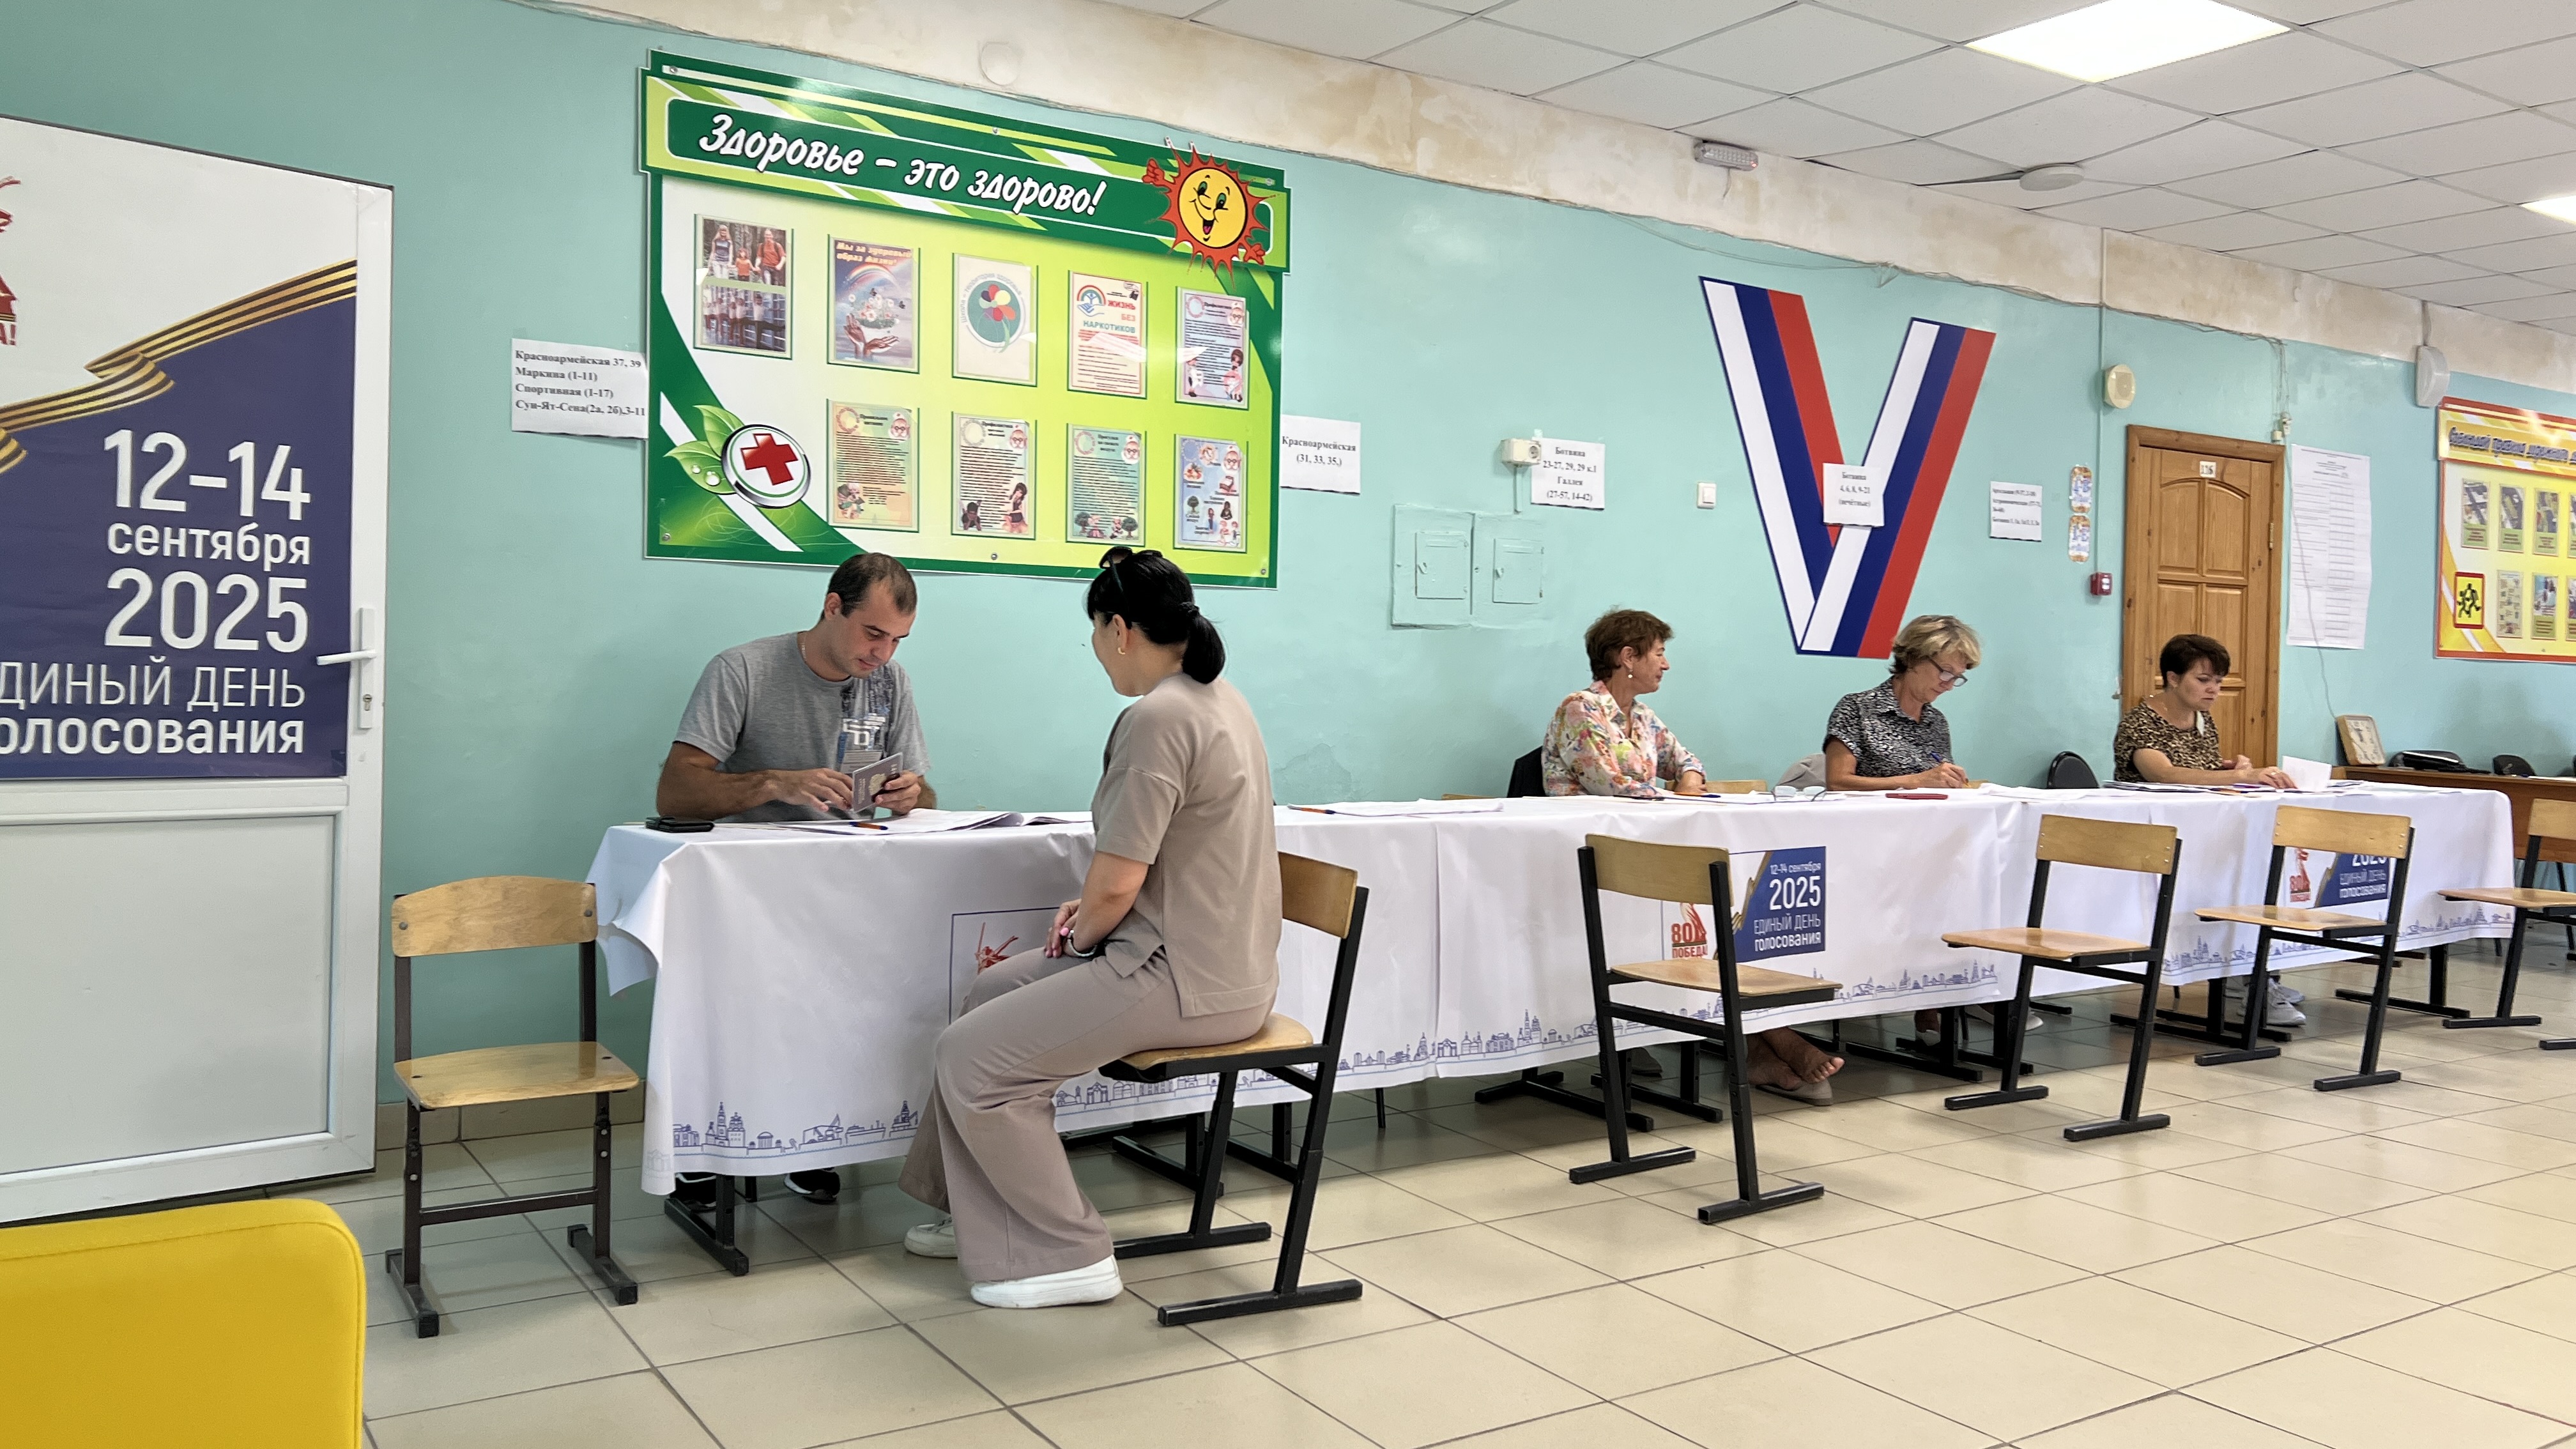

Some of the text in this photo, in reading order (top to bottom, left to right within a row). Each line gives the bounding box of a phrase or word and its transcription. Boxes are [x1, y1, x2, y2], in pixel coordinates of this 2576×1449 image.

[698, 113, 864, 173] Здоровье
[903, 158, 959, 192] это
[967, 169, 1107, 216] здорово!
[1107, 300, 1136, 310] ЖИЗНЬ
[1083, 320, 1135, 334] НАРКОТИКОВ
[1121, 313, 1135, 321] БЕЗ
[515, 350, 641, 368] Красноармейская 37, 39
[515, 367, 598, 382] Маркина (1-11)
[516, 383, 614, 399] Спортивная (1-17)
[1282, 436, 1356, 451] Красноармейская
[1296, 454, 1312, 464] (31,
[1314, 455, 1326, 464] 33,
[107, 522, 310, 571] сентября
[104, 567, 309, 652] 2025
[0, 656, 305, 712] ДИНЫЙ ДЕНЬ
[0, 717, 304, 754] олосования
[1769, 876, 1821, 910] 2025
[1671, 923, 1692, 944] 80
[1754, 913, 1821, 936] ЕДИНЫЙ ДЕНЬ
[1754, 931, 1821, 952] голосования
